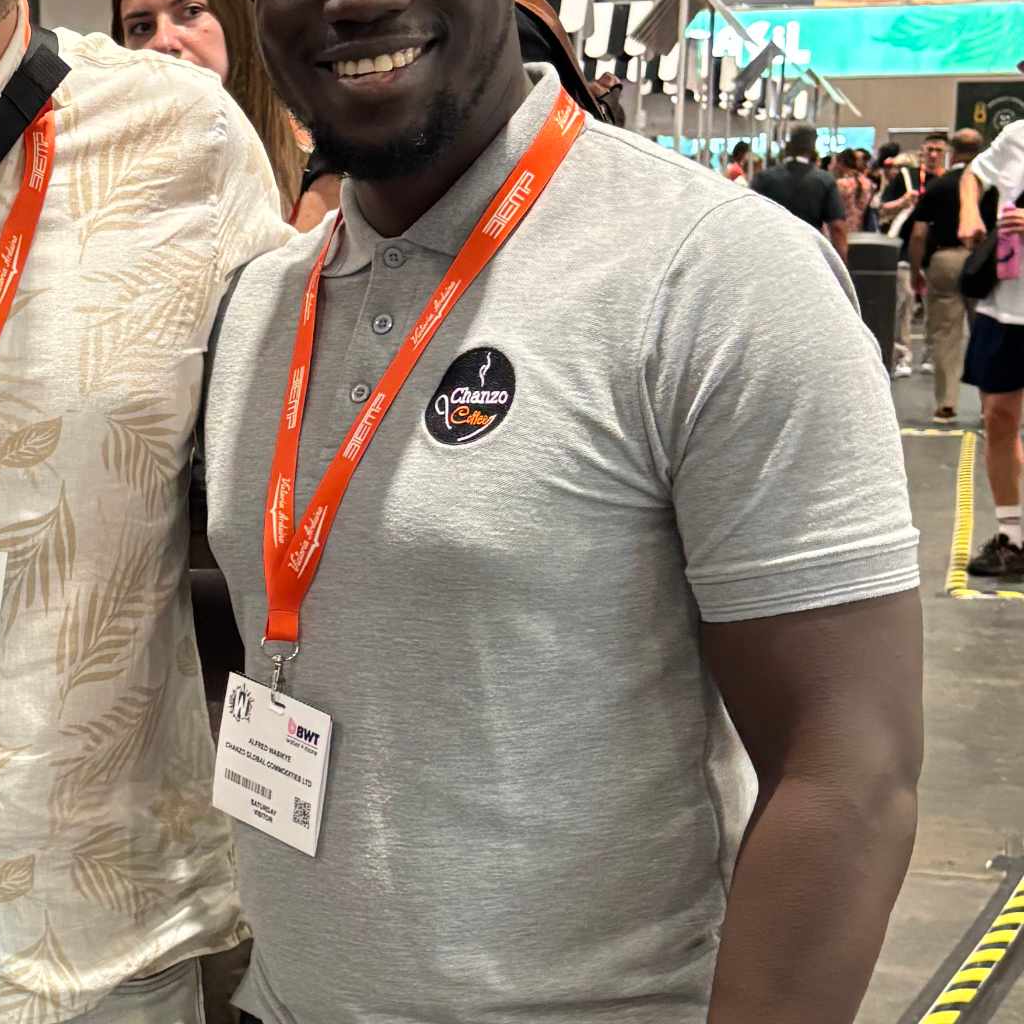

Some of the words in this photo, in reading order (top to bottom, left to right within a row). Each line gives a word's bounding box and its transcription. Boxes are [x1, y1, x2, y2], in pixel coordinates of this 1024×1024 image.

[450, 386, 509, 404] Chanzo
[450, 405, 490, 426] Coffee
[296, 725, 320, 746] BWT
